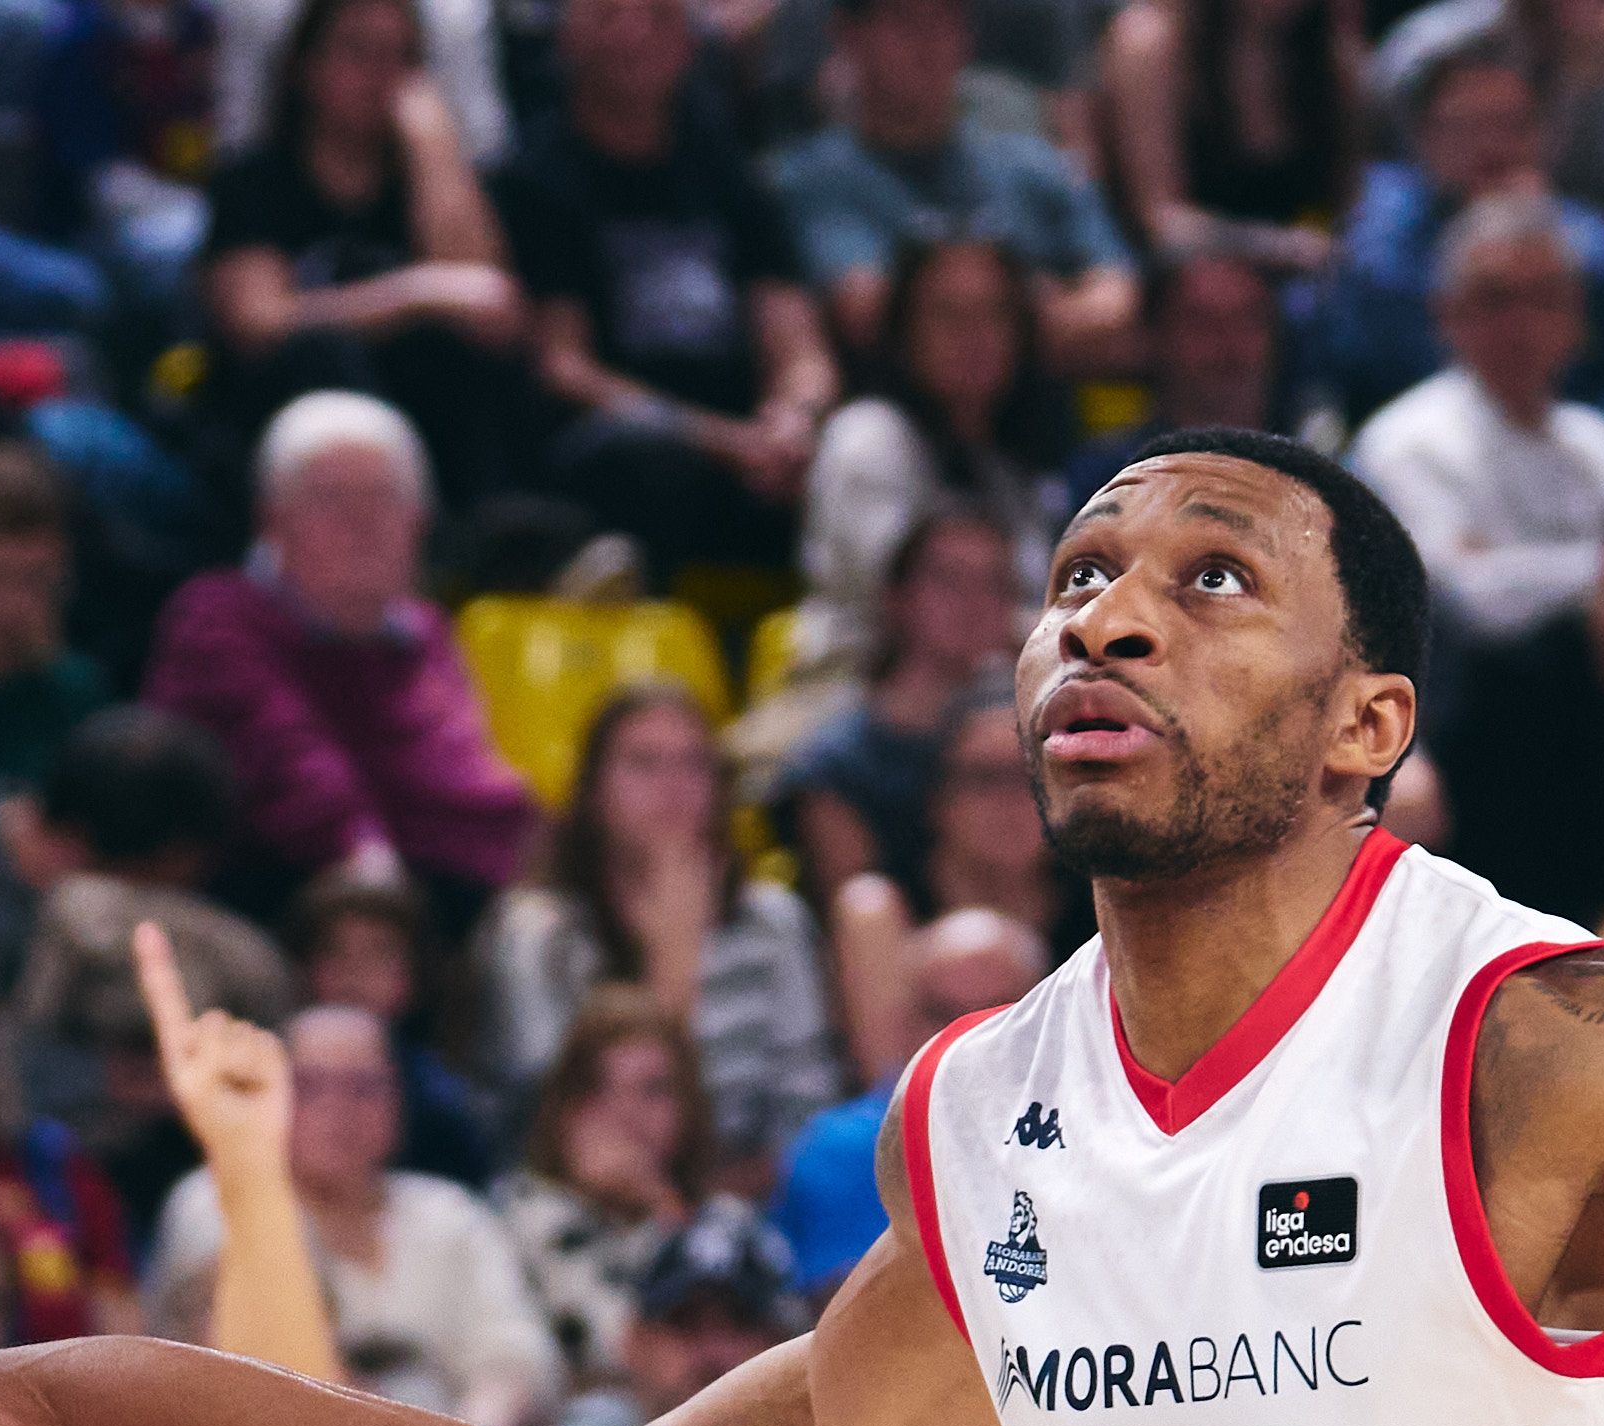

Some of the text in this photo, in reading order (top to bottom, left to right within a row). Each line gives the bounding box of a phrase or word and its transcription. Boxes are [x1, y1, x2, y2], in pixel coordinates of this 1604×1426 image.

[1265, 1207, 1305, 1236] liga
[1265, 1230, 1350, 1258] endesa
[1015, 1319, 1370, 1412] MORABANC
